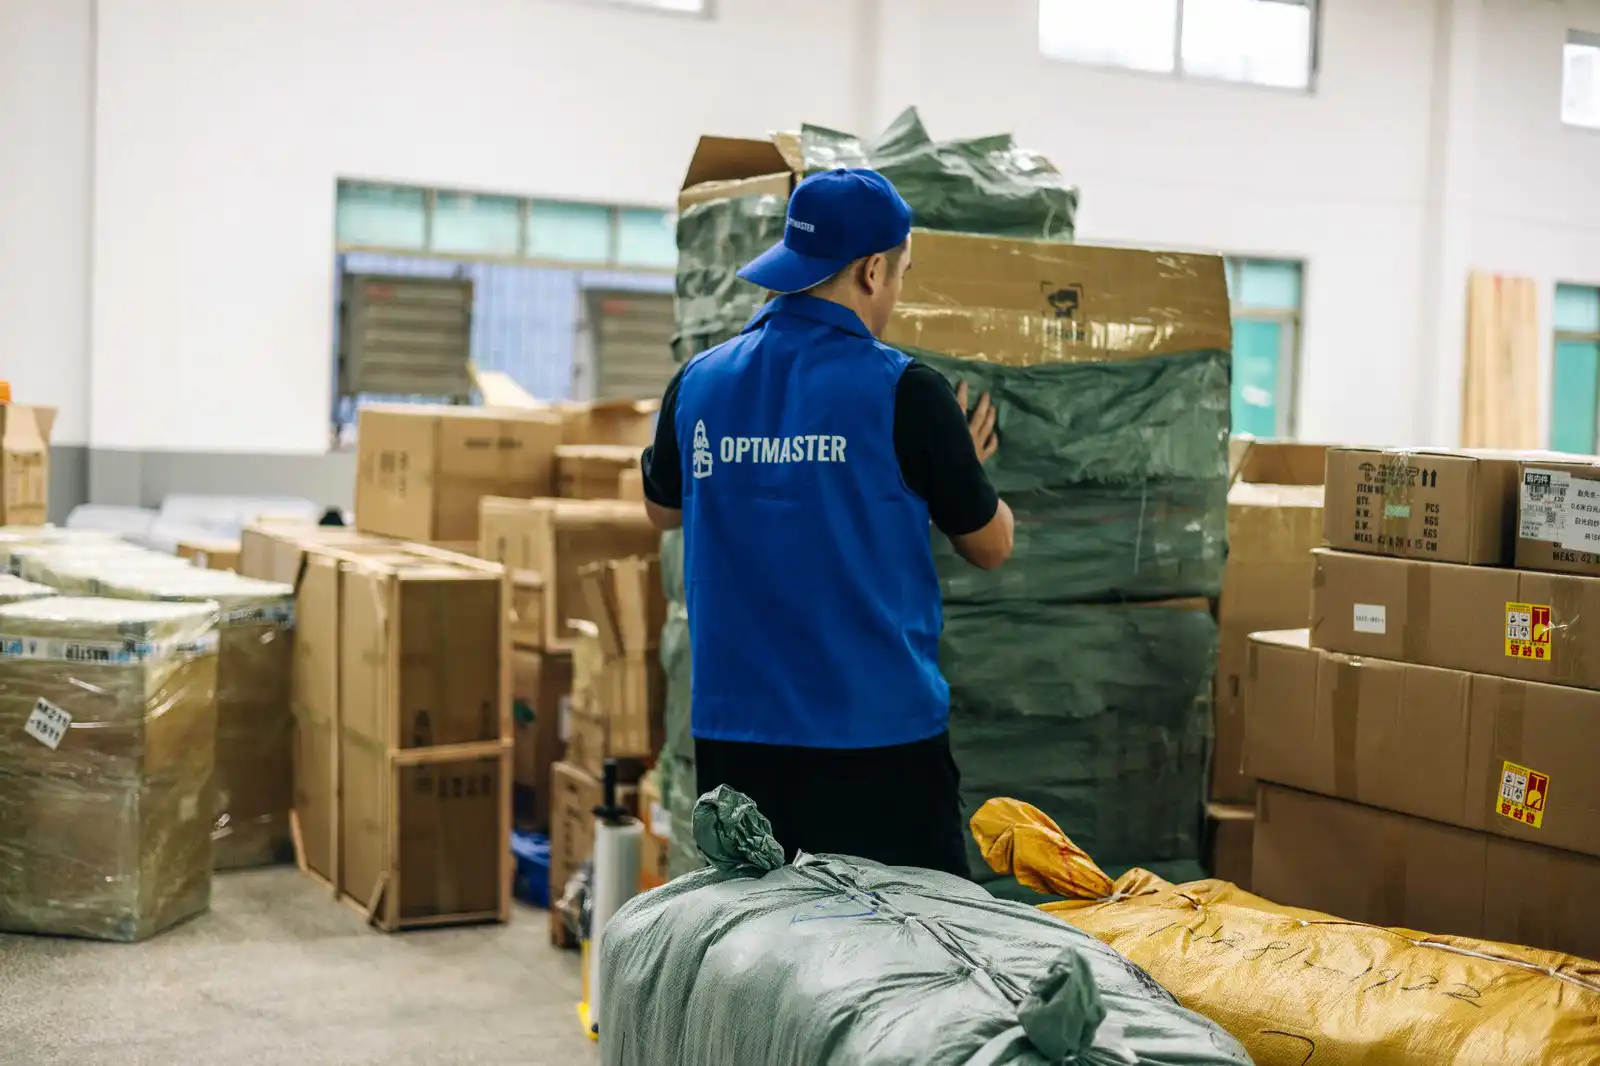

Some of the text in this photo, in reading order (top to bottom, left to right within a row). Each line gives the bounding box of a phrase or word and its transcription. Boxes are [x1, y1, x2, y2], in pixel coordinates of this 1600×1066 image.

[720, 435, 847, 463] OPTMASTER
[1425, 502, 1440, 514] PCS
[1424, 515, 1439, 526] KGS
[1423, 528, 1438, 539] KGS
[1414, 538, 1423, 549] 15
[1425, 540, 1438, 551] CM
